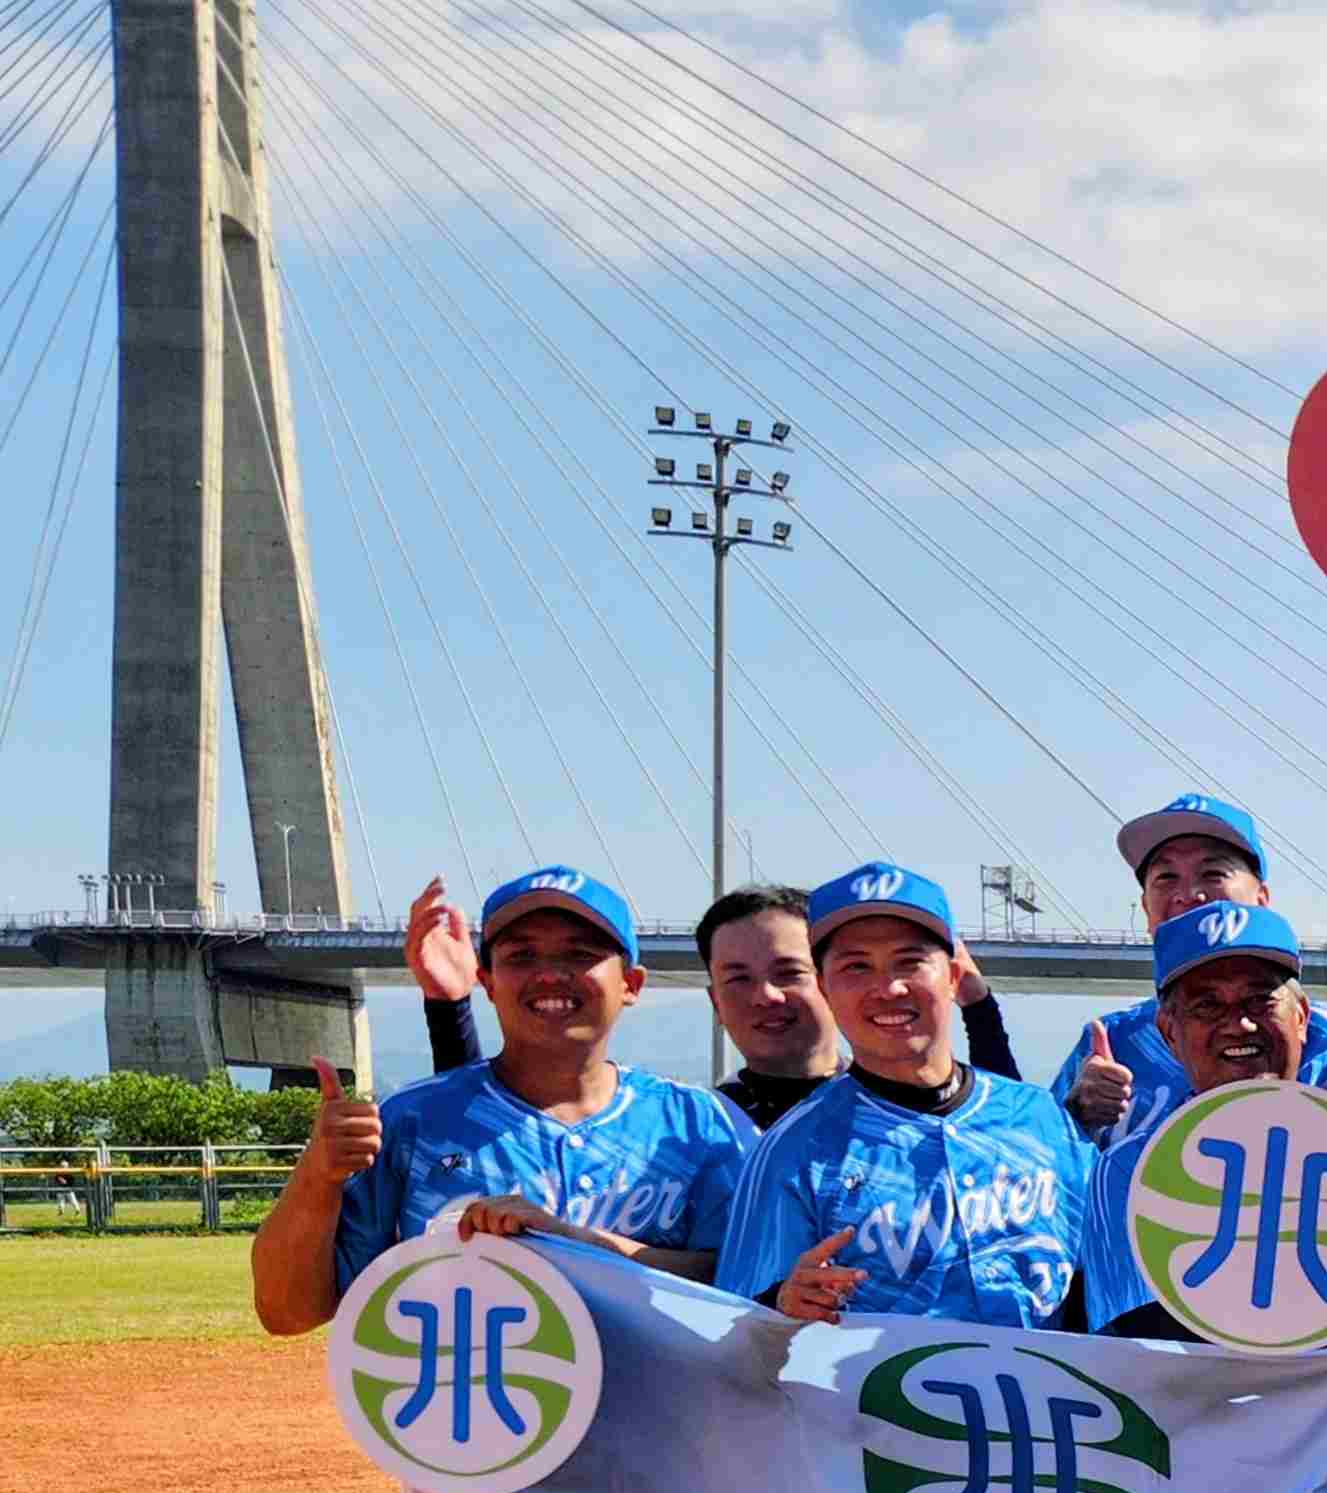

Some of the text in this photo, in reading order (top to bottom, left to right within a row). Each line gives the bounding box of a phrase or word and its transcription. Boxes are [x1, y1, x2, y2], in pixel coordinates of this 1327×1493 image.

[850, 869, 904, 901] W
[1198, 907, 1249, 945] W
[858, 1163, 1058, 1280] Water
